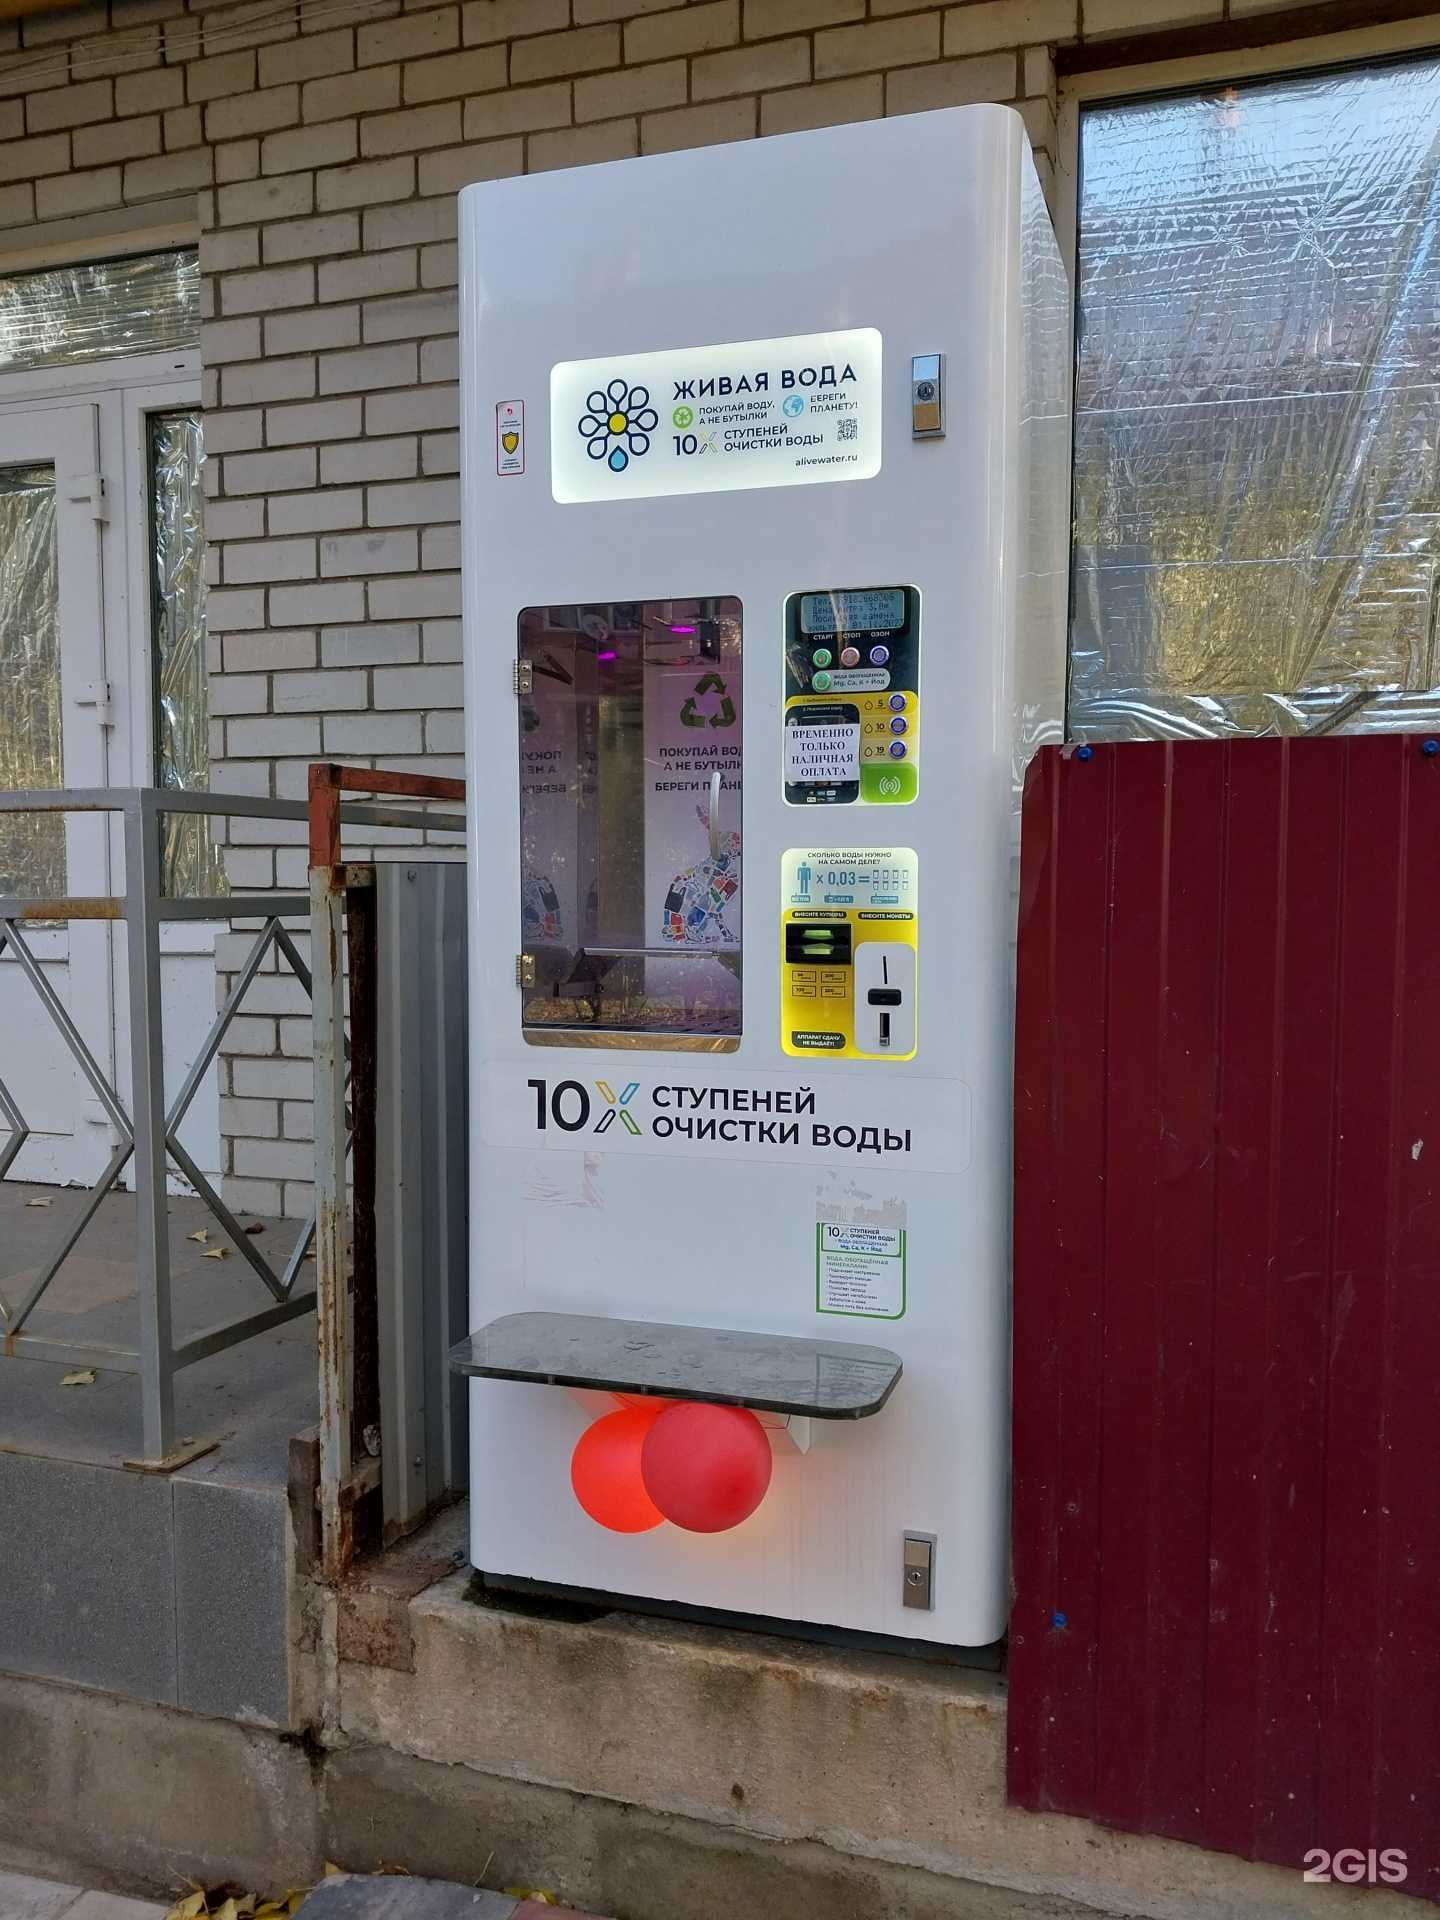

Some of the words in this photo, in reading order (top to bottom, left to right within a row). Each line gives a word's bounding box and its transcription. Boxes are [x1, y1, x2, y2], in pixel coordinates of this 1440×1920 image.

[673, 372, 769, 400] ЖИВАЯ
[781, 364, 857, 389] ВОДА
[810, 393, 846, 403] БЕРЕГИ
[699, 402, 745, 415] ПОКУПАЙ
[747, 400, 775, 411] ВОДУ,
[810, 402, 858, 413] ПЛАНЕТУ!
[708, 416, 720, 425] НЕ
[723, 412, 768, 423] БУТЫЛКИ
[724, 424, 788, 440] СТУПЕНЕЙ
[724, 436, 782, 452] ОЧИСТКИ
[786, 433, 824, 447] ВОДЫ
[795, 454, 858, 467] alivewater.ru
[878, 699, 884, 707] 5
[792, 728, 854, 739] ВРЕМЕННО
[659, 744, 718, 757] ПОКУПАЙ
[722, 746, 741, 757] ВО
[800, 741, 845, 751] ТОЛЬКО
[876, 746, 885, 754] 19
[792, 754, 853, 765] НАЛИЧНАЯ
[664, 761, 673, 771] А
[675, 761, 691, 771] НЕ
[801, 767, 847, 777] ОПЛАТА
[655, 781, 699, 792] БЕРЕГИ
[827, 871, 856, 886] 0,03
[652, 1086, 815, 1115] СТУПЕНЕЙ
[652, 1116, 800, 1145] ОЧИСТКИ
[812, 1124, 911, 1155] ВОДЫ
[850, 1227, 880, 1235] СТУПЕНЕЙ
